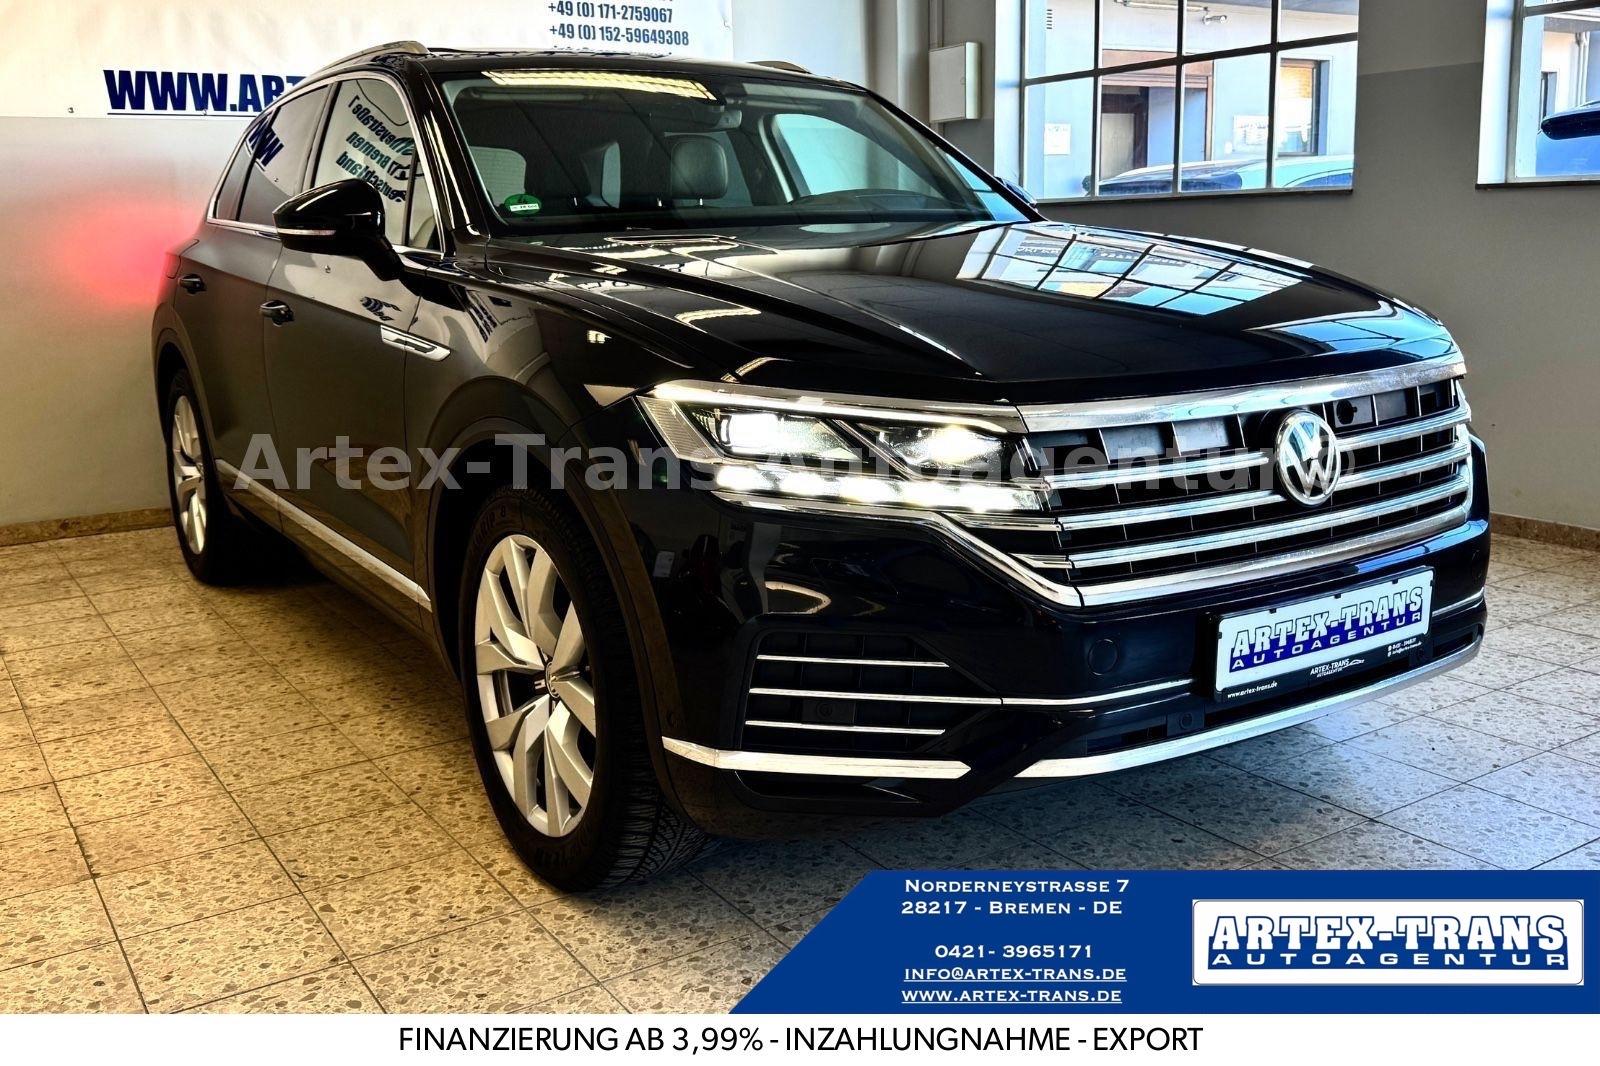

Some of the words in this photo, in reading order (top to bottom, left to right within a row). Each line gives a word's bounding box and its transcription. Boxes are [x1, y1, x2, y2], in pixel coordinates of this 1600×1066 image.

[548, 0, 573, 16] +49
[577, 2, 594, 18] (0)
[599, 4, 673, 23] 171-2759067
[549, 23, 574, 39] +49
[578, 25, 596, 40] (0)
[599, 26, 689, 46] 152-59649308
[1232, 587, 1423, 658] ARTEX-TRANS
[1231, 613, 1422, 670] AUTOAGENTUR
[1310, 658, 1350, 676] ARTEX-TRANS
[1227, 680, 1278, 699] www.artex-trans.de
